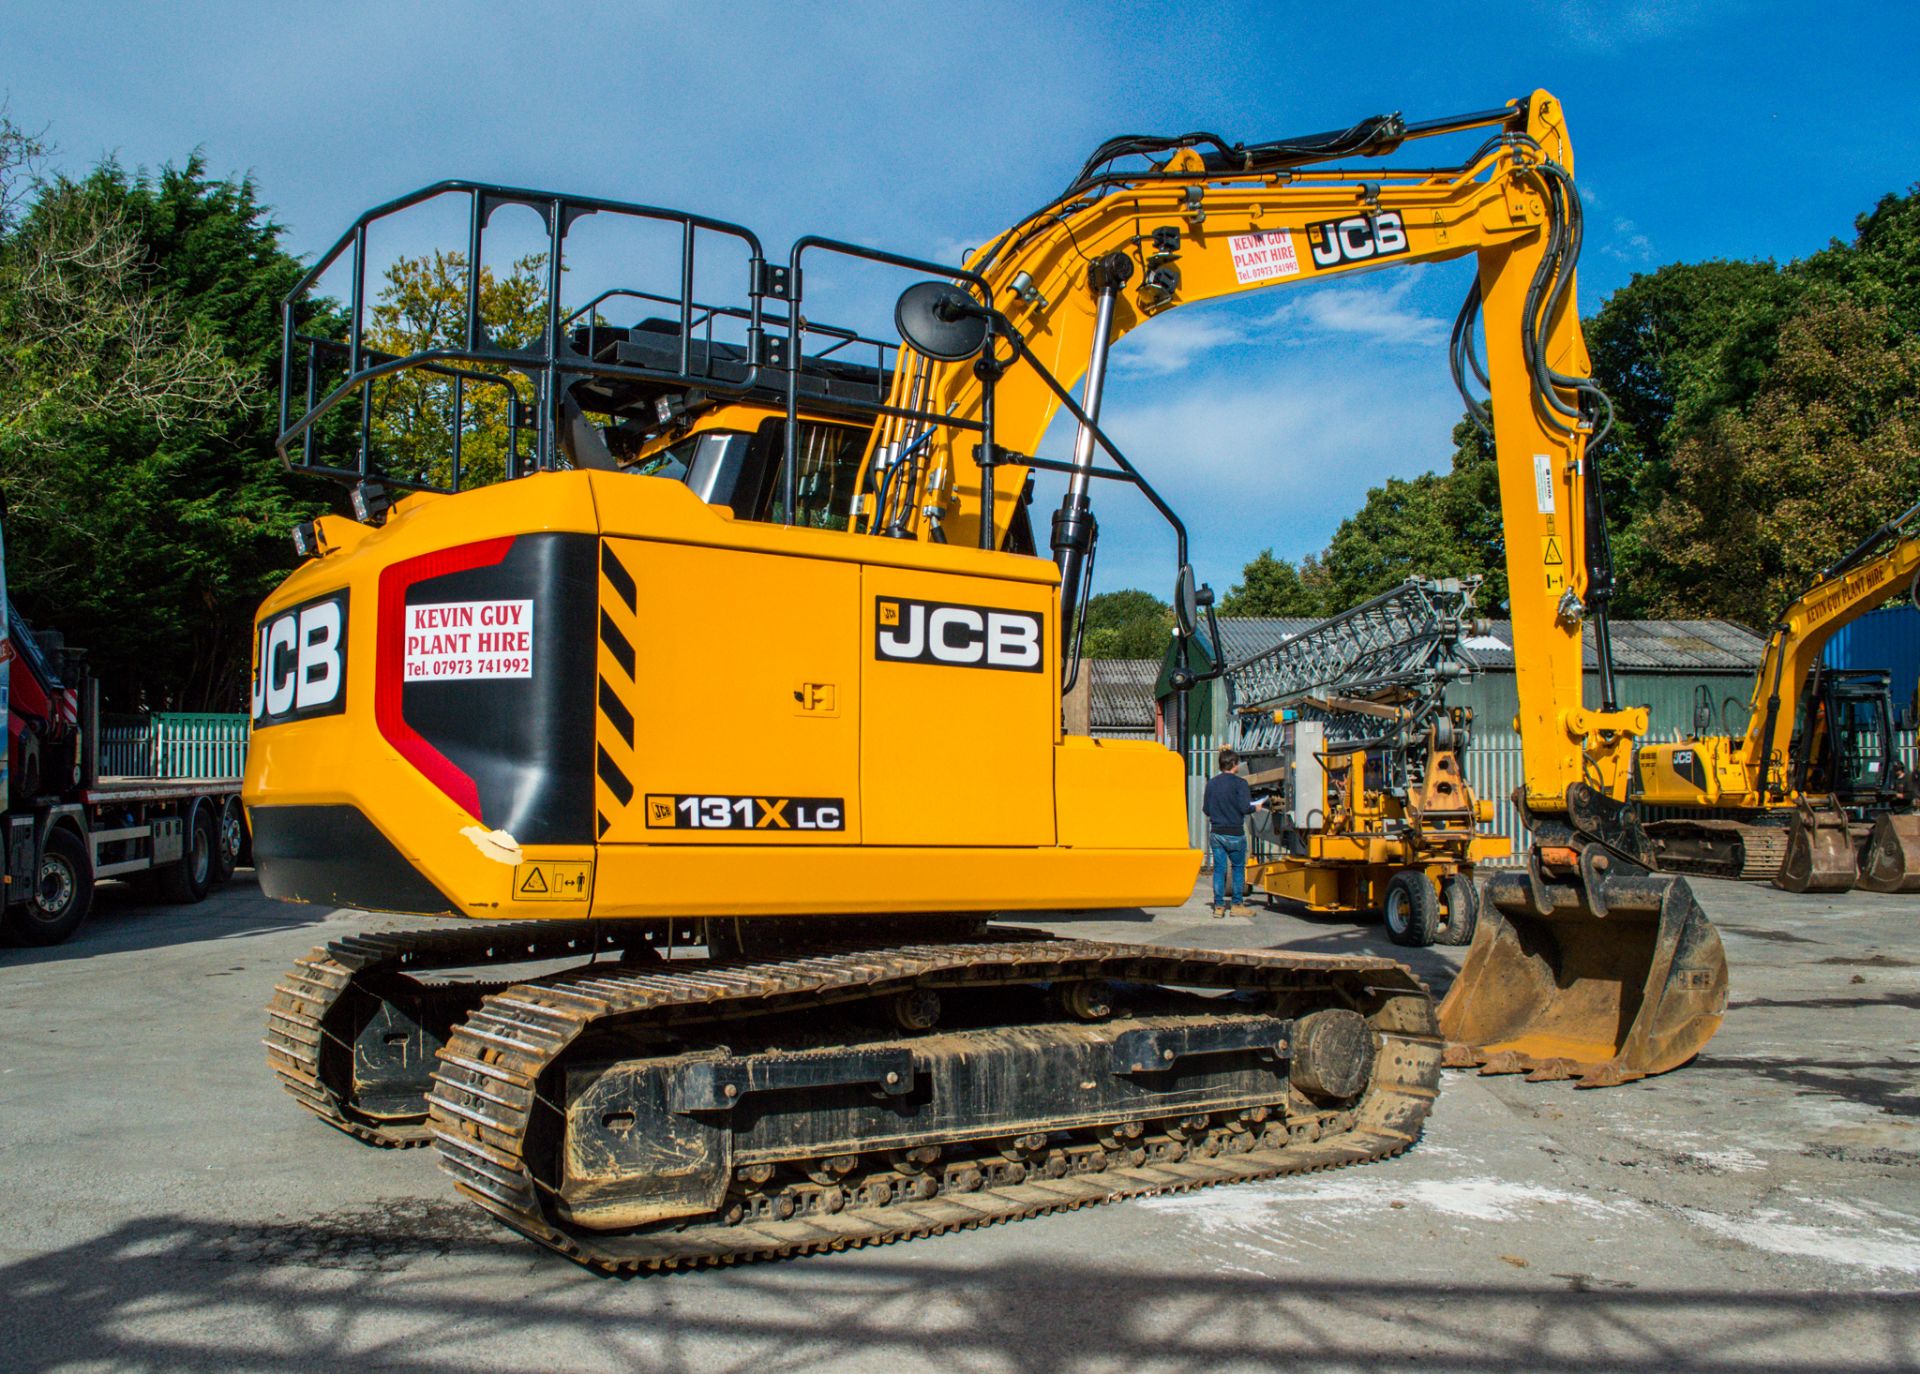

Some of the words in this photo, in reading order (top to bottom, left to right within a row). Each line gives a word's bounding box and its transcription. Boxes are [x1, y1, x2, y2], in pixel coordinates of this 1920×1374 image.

[1233, 232, 1267, 251] KEVIN
[1267, 231, 1288, 246] GUY
[1313, 212, 1406, 264] JCB
[1234, 252, 1268, 268] PLANT
[1270, 245, 1295, 261] HIRE
[1238, 270, 1252, 282] Tel.
[1252, 266, 1273, 279] 07973
[1275, 261, 1299, 275] 741992
[1806, 604, 1827, 625] KEVIN
[1827, 593, 1841, 613] GUY
[1841, 576, 1866, 605] PLANT
[1866, 565, 1886, 590] HIRE
[414, 606, 474, 629] KEVIN
[480, 604, 523, 627] GUY
[408, 633, 472, 656] PLANT
[478, 631, 530, 652] HIRE
[879, 604, 1040, 667] JCB
[252, 601, 342, 719] JCB
[407, 661, 429, 677] Tel.
[433, 659, 473, 676] 07973
[477, 658, 529, 674] 741992
[1673, 751, 1692, 764] JCB
[678, 797, 790, 829] 131X
[797, 806, 841, 829] LC
